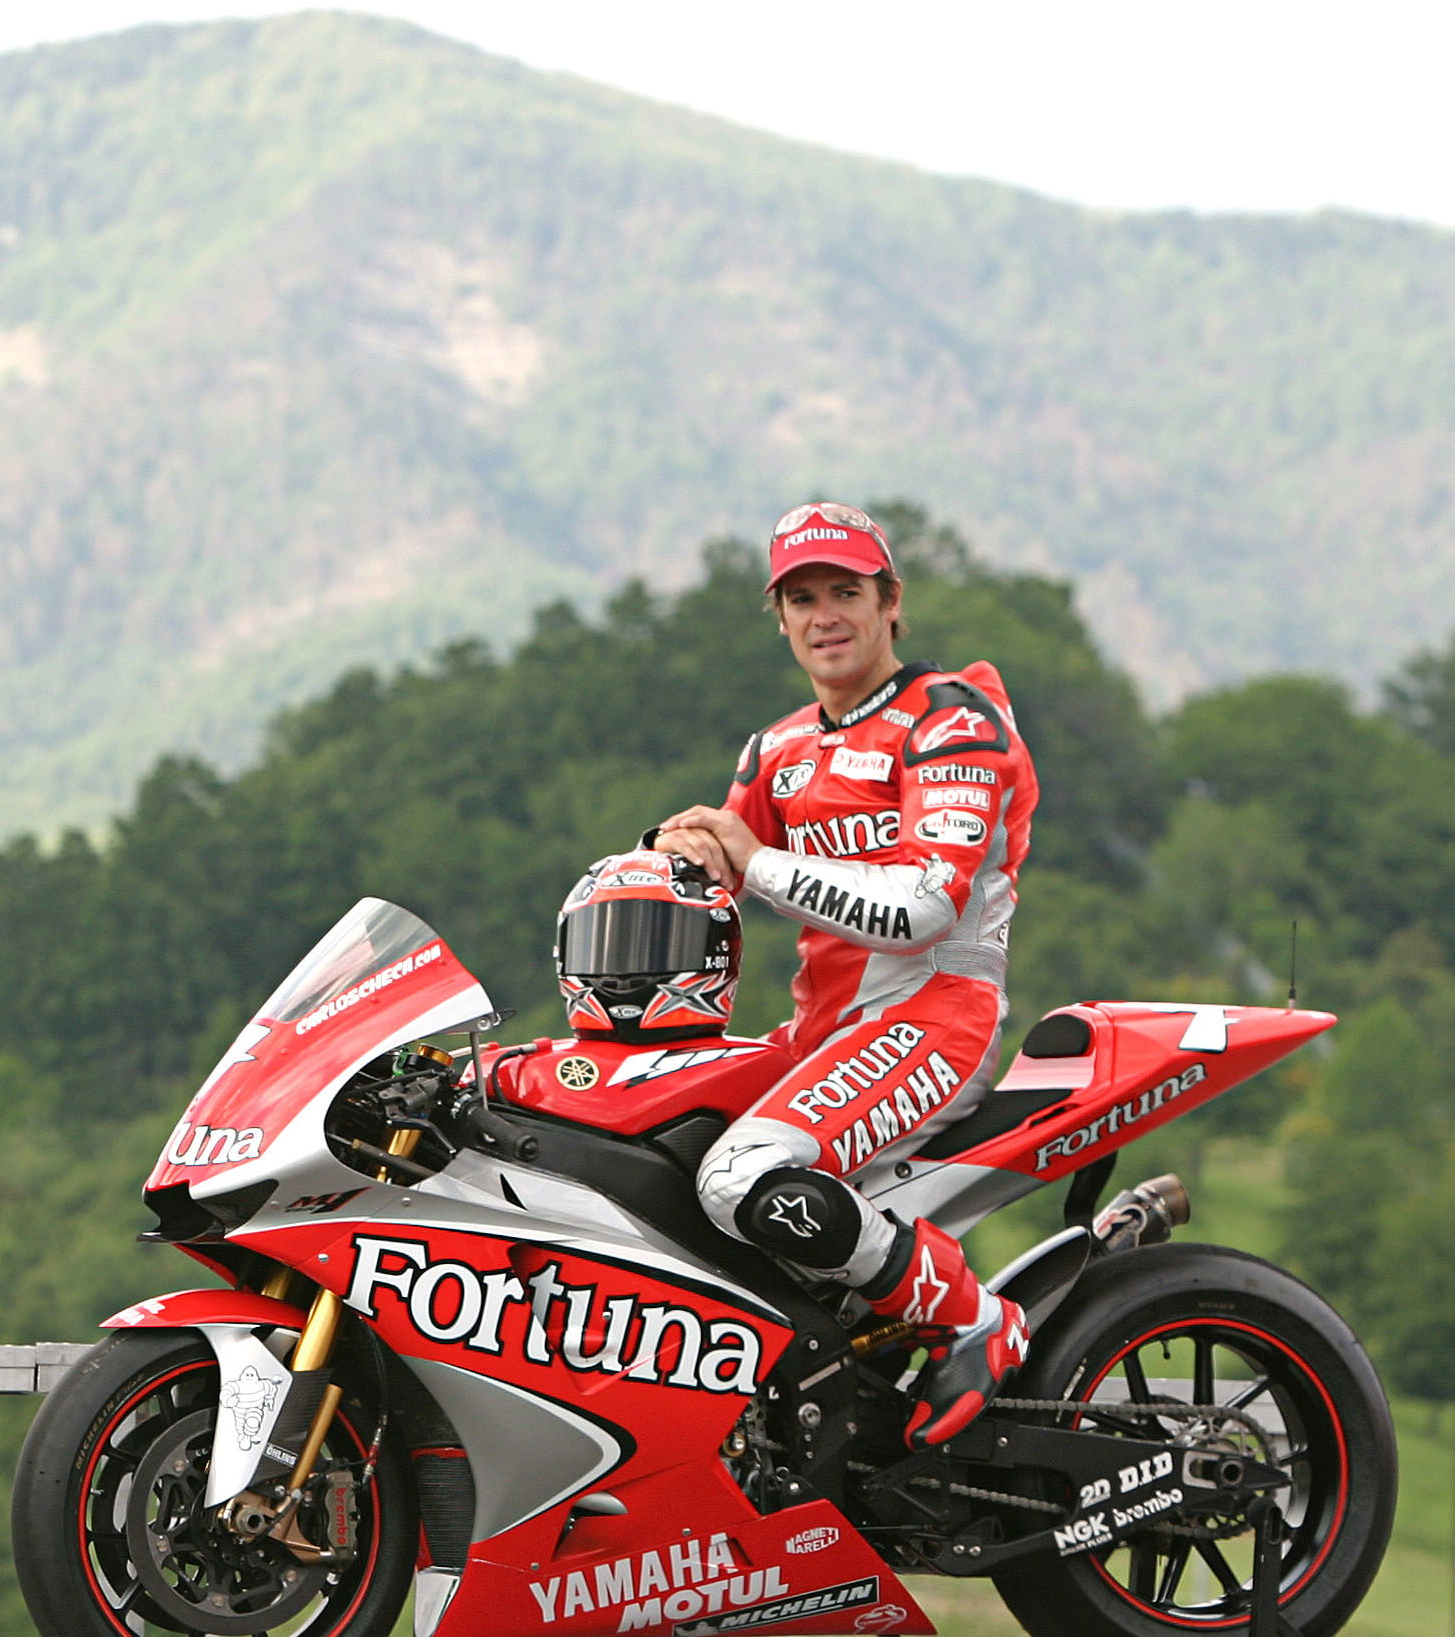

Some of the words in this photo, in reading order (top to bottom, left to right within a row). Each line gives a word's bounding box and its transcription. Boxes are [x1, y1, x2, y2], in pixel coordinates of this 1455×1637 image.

[918, 763, 995, 785] Fortuna
[925, 789, 988, 809] MOTUL
[786, 811, 901, 856] ortuna
[786, 868, 913, 940] YAMAHA
[787, 1021, 927, 1125] Fortuna
[831, 1050, 962, 1174] YAMAHA
[1034, 1062, 1207, 1172] Fortuna
[342, 1235, 759, 1396] Fortuna
[334, 1487, 346, 1546] brembo
[1054, 1512, 1110, 1551] NGK
[1113, 1488, 1184, 1528] brembo
[529, 1532, 739, 1624] YAMAHA
[617, 1566, 790, 1634] MOTUL
[717, 1582, 874, 1632] MICHELIN
